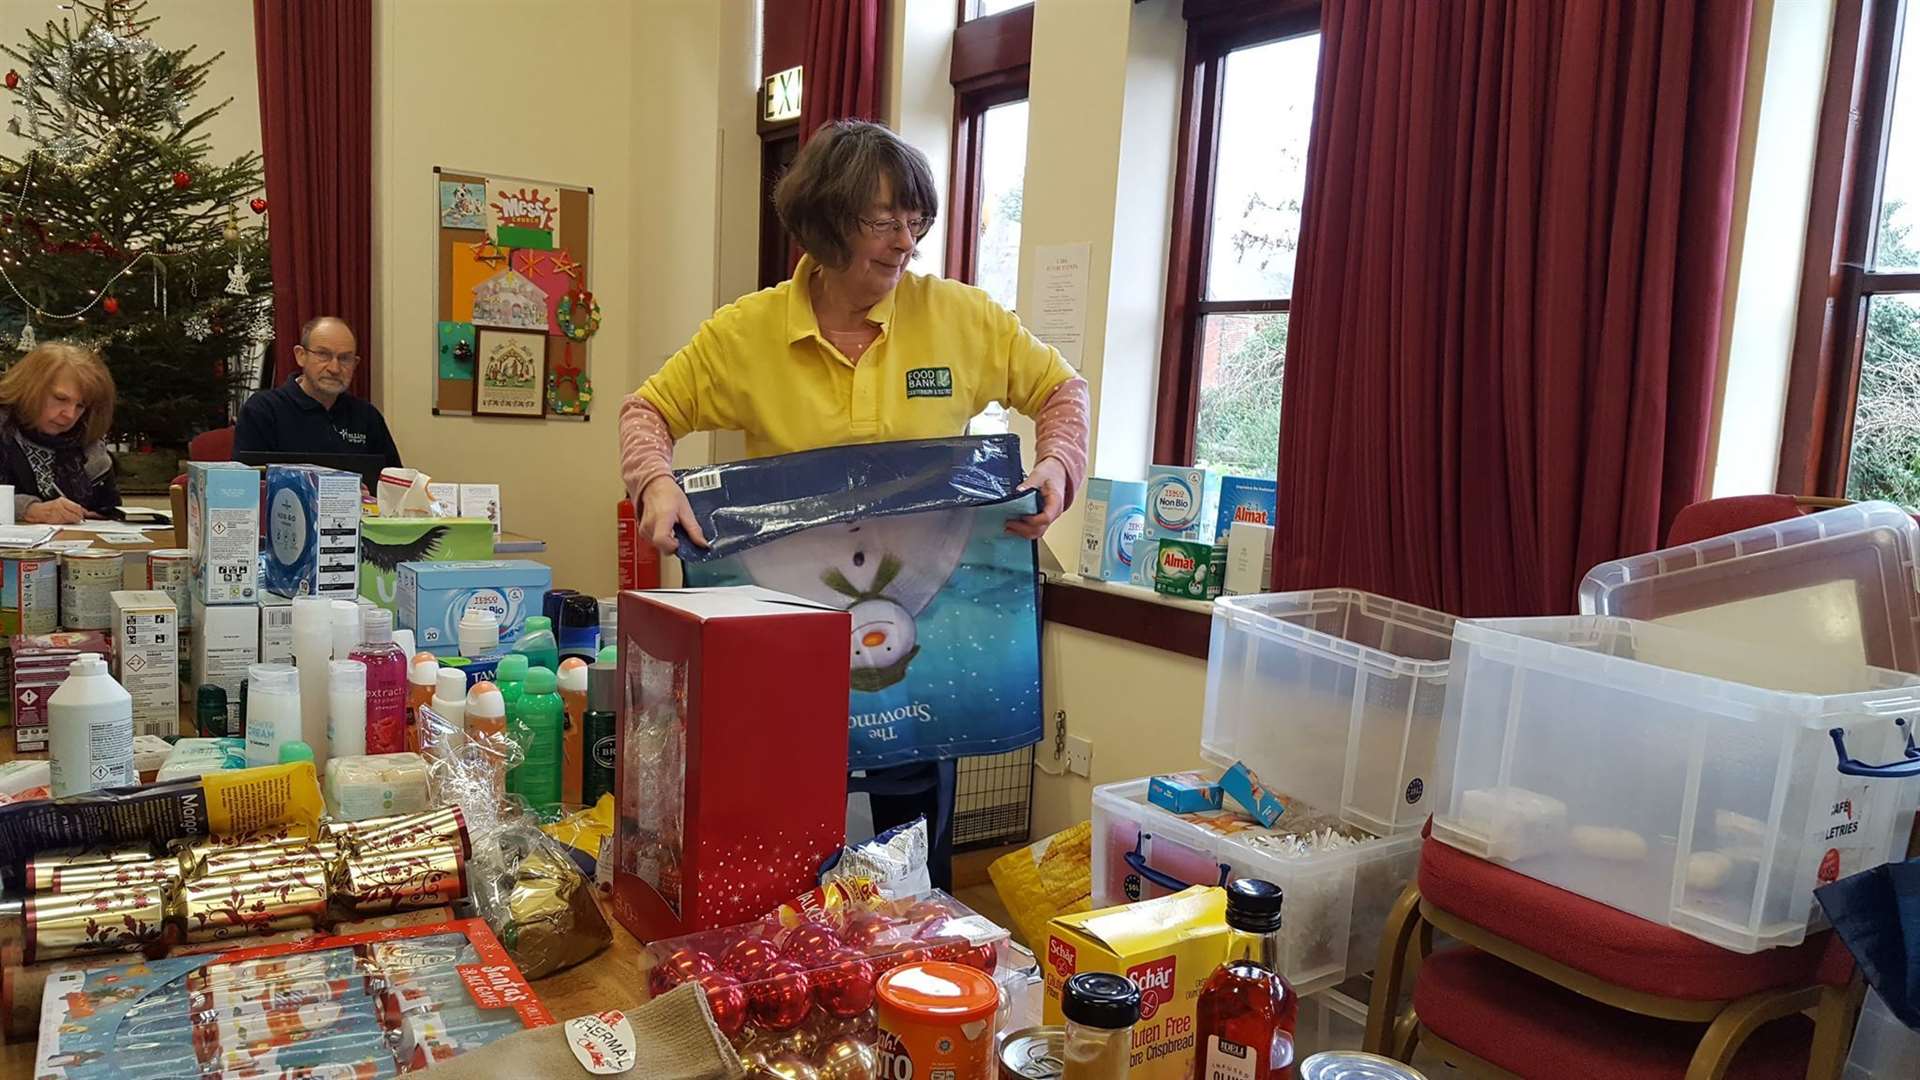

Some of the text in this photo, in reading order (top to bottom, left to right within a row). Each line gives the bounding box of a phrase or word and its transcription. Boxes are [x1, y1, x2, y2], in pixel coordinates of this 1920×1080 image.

[765, 68, 802, 119] EXI
[502, 197, 549, 229] Messy
[907, 370, 935, 381] FOOD
[908, 379, 936, 388] BANK
[1159, 498, 1189, 508] Non Bio
[1235, 505, 1268, 525] Almat
[1123, 532, 1137, 541] Non
[1164, 553, 1195, 571] Almat
[474, 595, 498, 605] TESCO
[426, 632, 438, 640] 20
[472, 669, 497, 683] TAM
[848, 700, 931, 729] Snowma
[868, 726, 898, 742] The
[602, 748, 617, 756] BR
[1050, 939, 1075, 967] Schär
[480, 965, 529, 1002] Santa's
[1131, 966, 1173, 991] Schär
[1131, 1015, 1191, 1050] luten Free
[572, 1018, 632, 1068] THERMAL
[1130, 1050, 1143, 1067] bre
[1146, 1032, 1194, 1060] Crispbread
